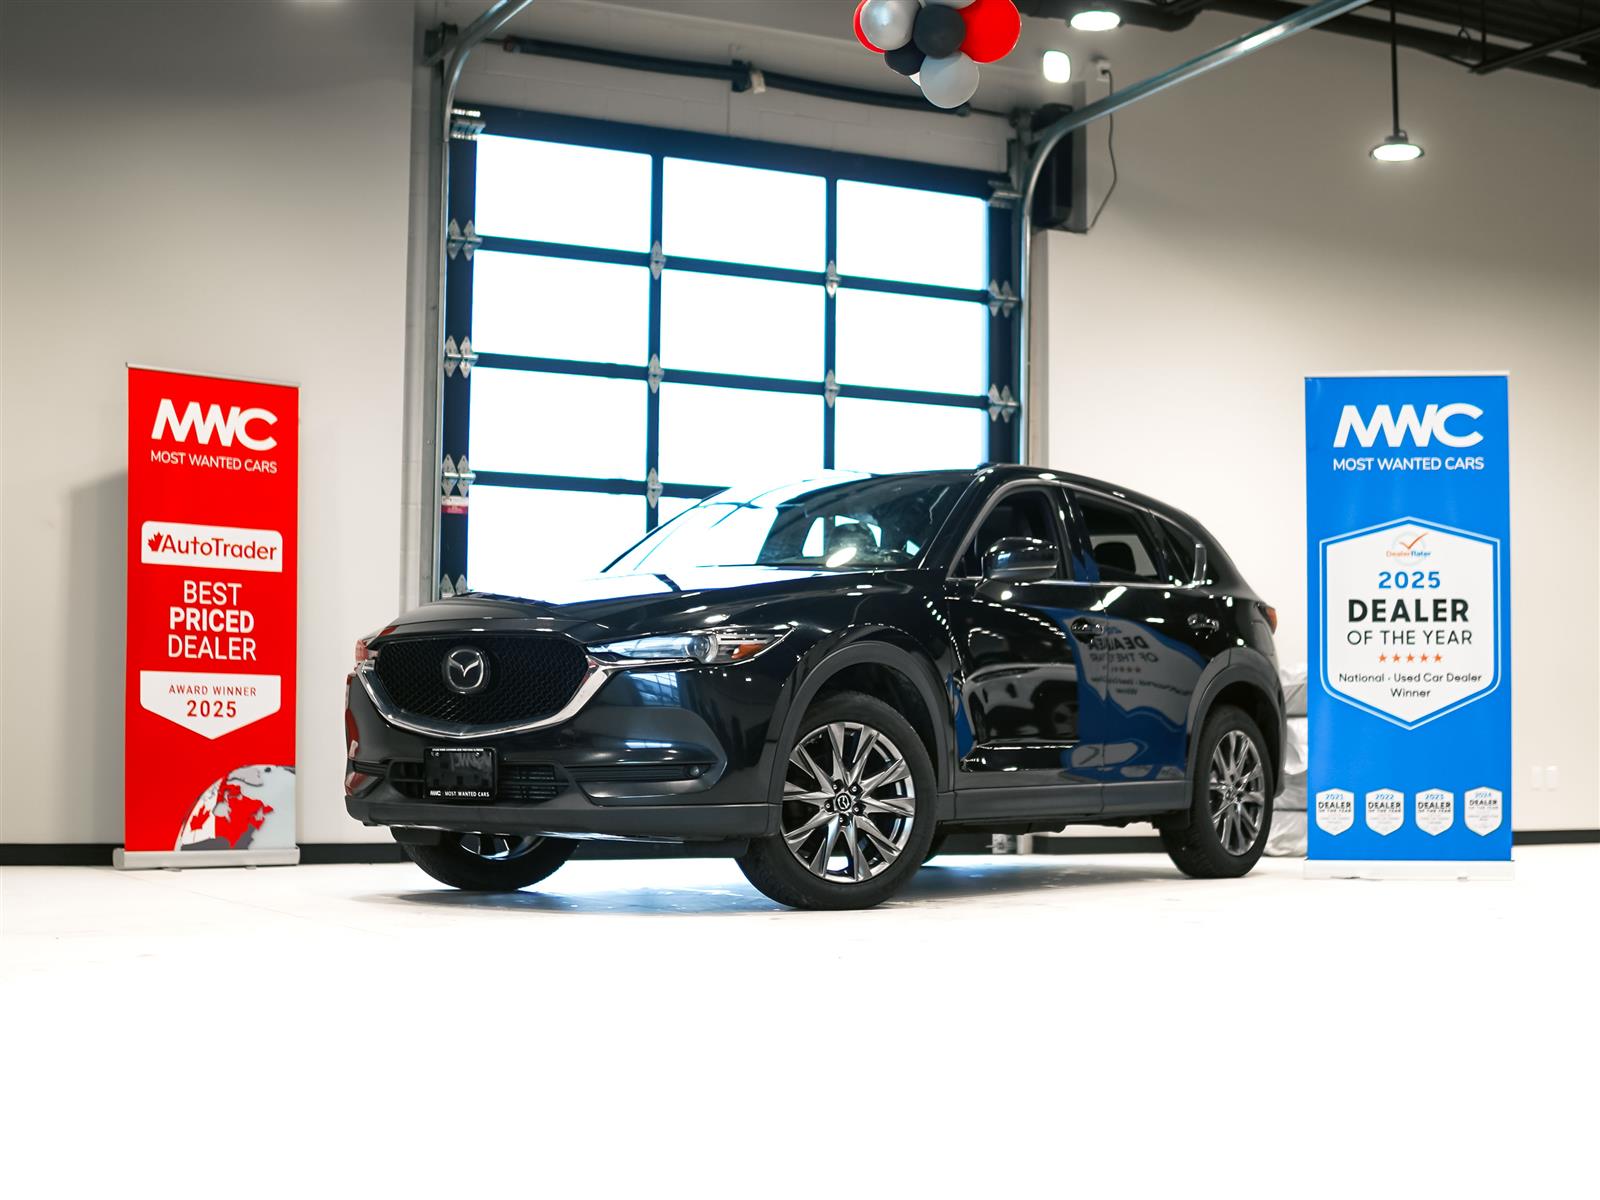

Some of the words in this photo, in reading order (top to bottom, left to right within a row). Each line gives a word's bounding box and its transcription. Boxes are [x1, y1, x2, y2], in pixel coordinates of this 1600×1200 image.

[151, 398, 278, 451] MWC
[1333, 403, 1484, 448] MWC
[150, 450, 186, 465] MOST
[189, 454, 242, 471] WANTED
[244, 459, 278, 474] CARS
[1333, 457, 1374, 471] MOST
[1377, 457, 1441, 471] WANTED
[1445, 456, 1485, 471] CARS
[161, 534, 277, 560] AutoTrader
[1378, 571, 1441, 589] 2025
[183, 580, 242, 606] BEST
[169, 606, 255, 633] PRICED
[1348, 599, 1469, 622] DEALER
[167, 633, 257, 661] DEALER
[1347, 630, 1373, 646] OF
[1379, 630, 1416, 645] THE
[1423, 630, 1473, 645] YEAR
[1339, 673, 1385, 683] National
[1393, 673, 1421, 683] Used
[1423, 673, 1443, 683] Car
[1446, 673, 1483, 683] Dealer
[168, 684, 208, 696] AWARD
[212, 686, 257, 697] WINNER
[1390, 688, 1431, 698] Winner
[186, 699, 237, 718] 2025
[1318, 801, 1351, 809] DEALER
[1368, 801, 1401, 809] DEALER
[1417, 801, 1451, 809] DEALER
